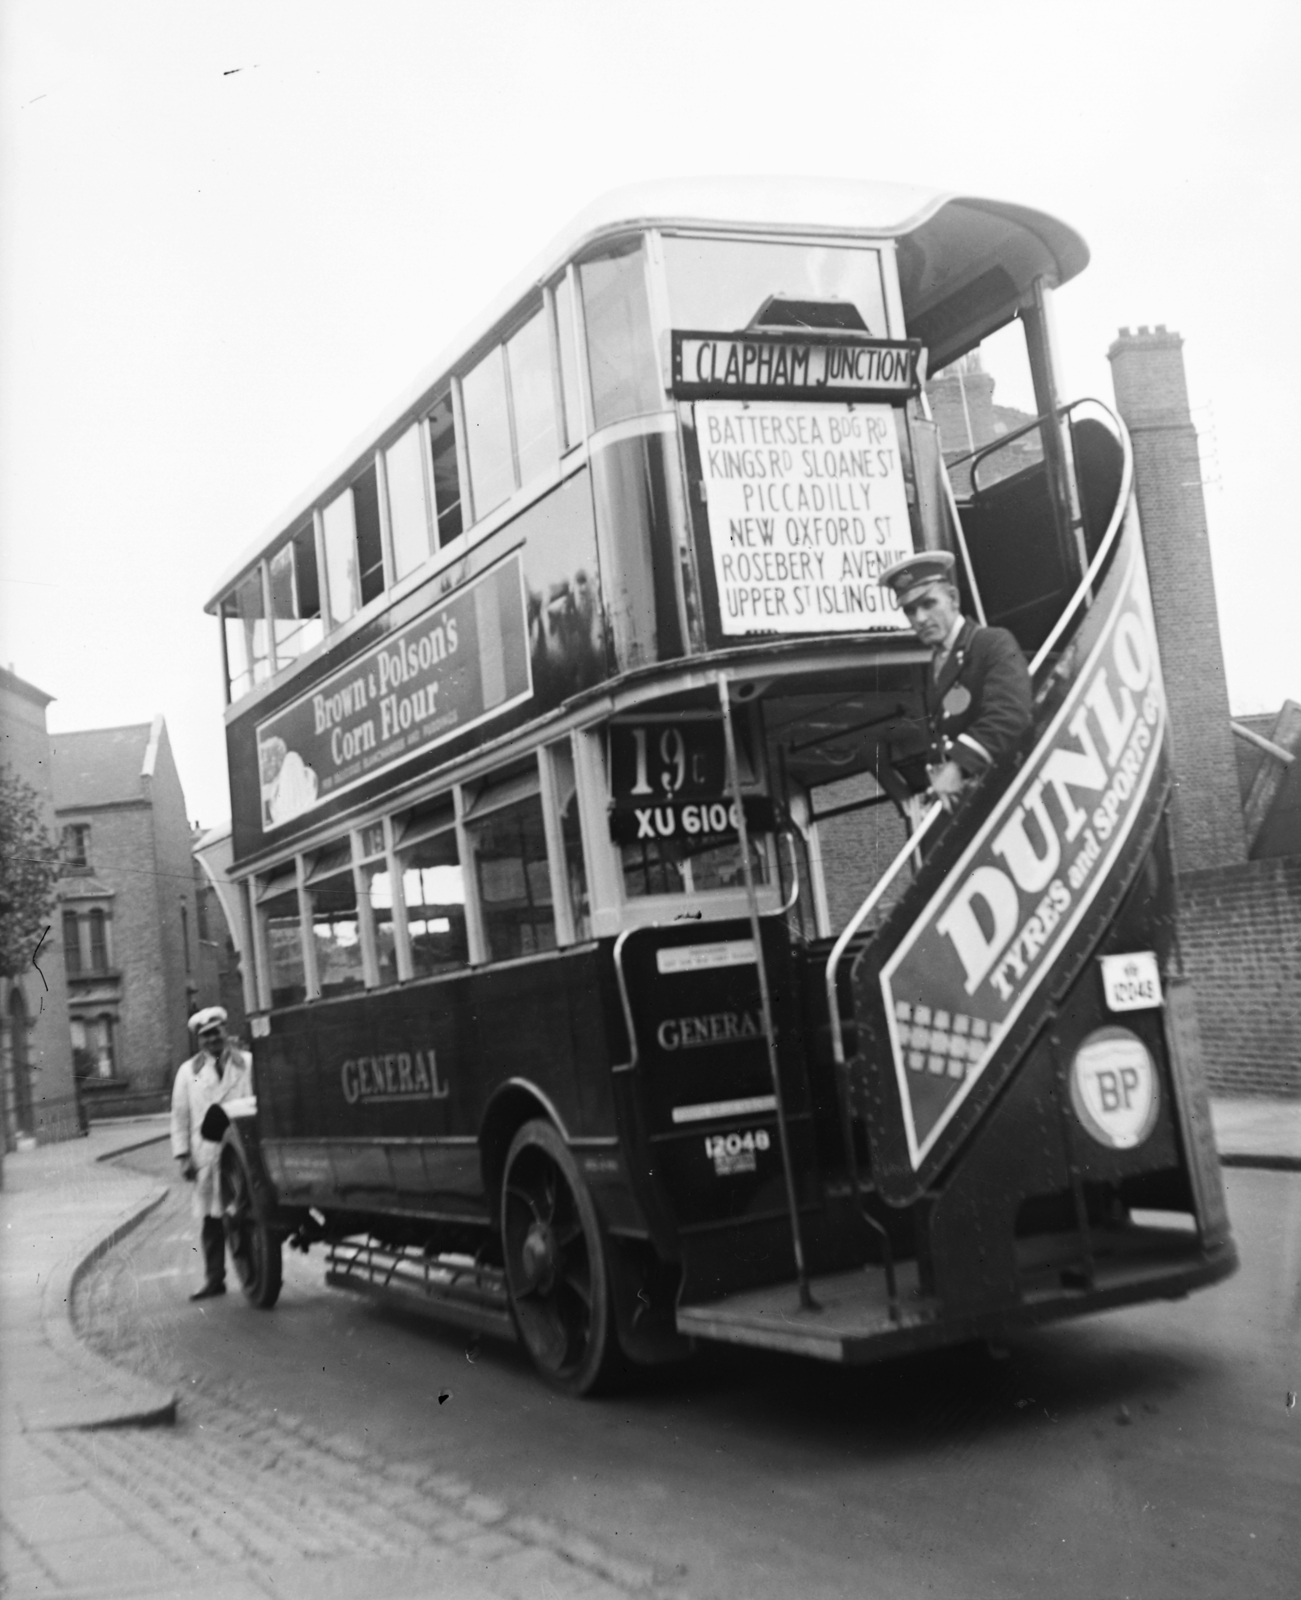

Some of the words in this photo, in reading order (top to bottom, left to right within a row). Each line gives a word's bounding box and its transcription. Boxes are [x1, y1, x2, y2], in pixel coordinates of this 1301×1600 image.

[696, 342, 811, 386] CLAPHAM
[816, 348, 910, 385] JUNCTION
[707, 415, 824, 445] BATTERSEA
[707, 449, 768, 479] KINGS
[802, 449, 875, 479] SLOANE
[742, 482, 871, 513] PICCADILLY
[729, 517, 774, 547] NEW
[785, 517, 866, 547] OXFORD
[721, 551, 824, 582] ROSEBERY
[842, 550, 907, 579] AVEN
[726, 585, 789, 618] UPPER
[816, 583, 901, 614] ISLINGTO
[312, 677, 367, 736] Brown
[377, 611, 458, 697] Polson's
[331, 719, 376, 766] Corn
[379, 681, 439, 741] Flour
[634, 807, 676, 839] XU
[935, 611, 1152, 997] DUNLO
[989, 879, 1072, 1002] TYRES
[1068, 828, 1101, 890] and
[1093, 716, 1151, 840] SPORTS
[341, 1049, 449, 1104] GENERAL
[1095, 1066, 1139, 1112] BP
